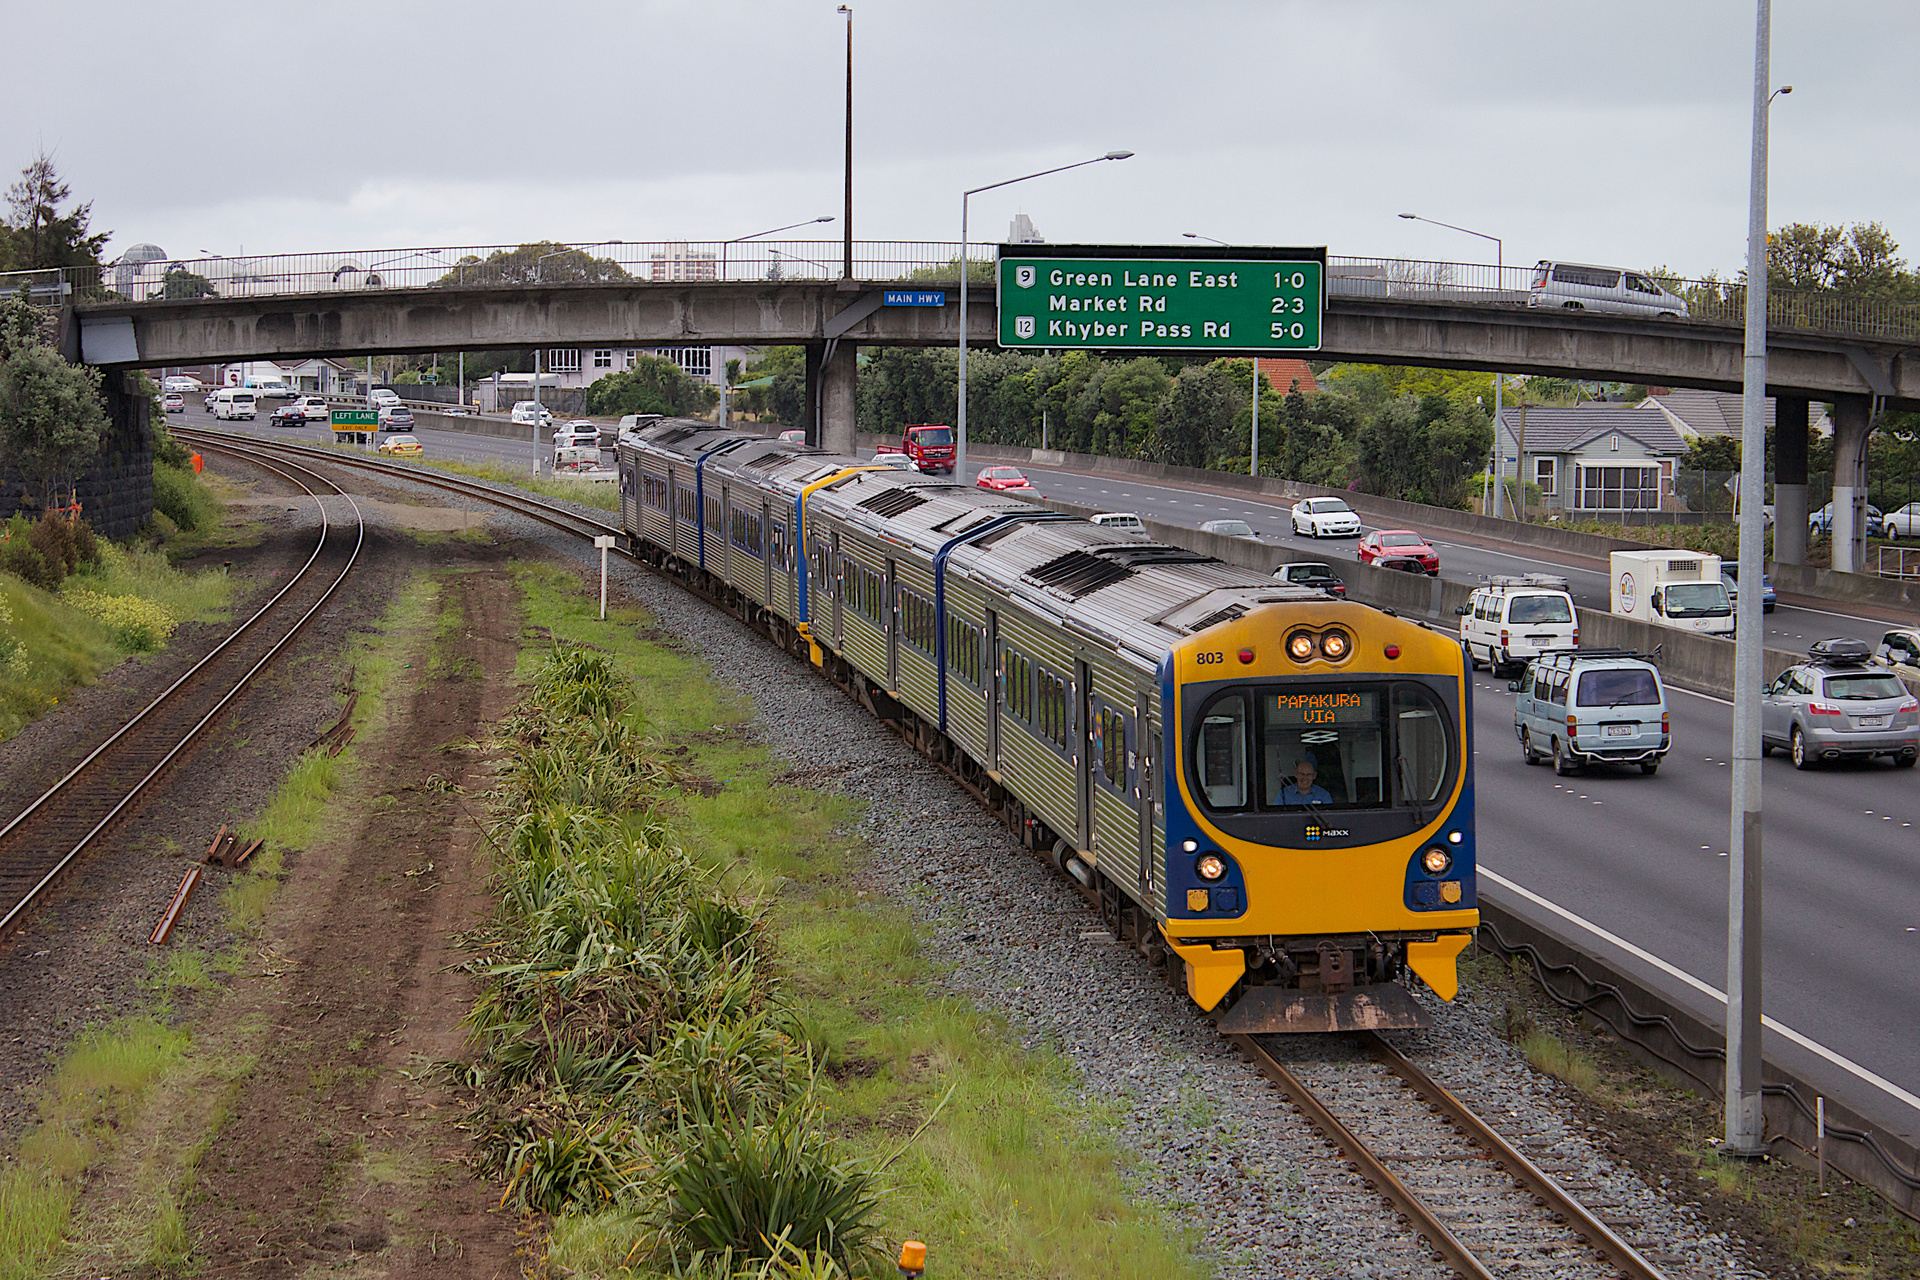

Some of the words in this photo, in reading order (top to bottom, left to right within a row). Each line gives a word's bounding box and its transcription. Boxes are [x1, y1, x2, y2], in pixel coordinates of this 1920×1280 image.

[1021, 270, 1031, 282] 9
[1050, 269, 1112, 287] Green
[1124, 271, 1178, 288] Lane
[1189, 271, 1238, 288] East
[888, 294, 913, 303] MAIN
[918, 294, 940, 303] HWY
[1049, 295, 1127, 312] Market
[1139, 296, 1166, 312] Rd
[1019, 321, 1031, 333] 12
[1049, 320, 1128, 341] Khyber
[1140, 321, 1191, 338] Pass
[1203, 321, 1231, 338] Rd
[335, 412, 352, 420] LEFT
[356, 412, 375, 420] LANE
[1196, 651, 1224, 665] 803
[1277, 693, 1361, 709] PAPAKURA
[1303, 709, 1335, 724] VIA
